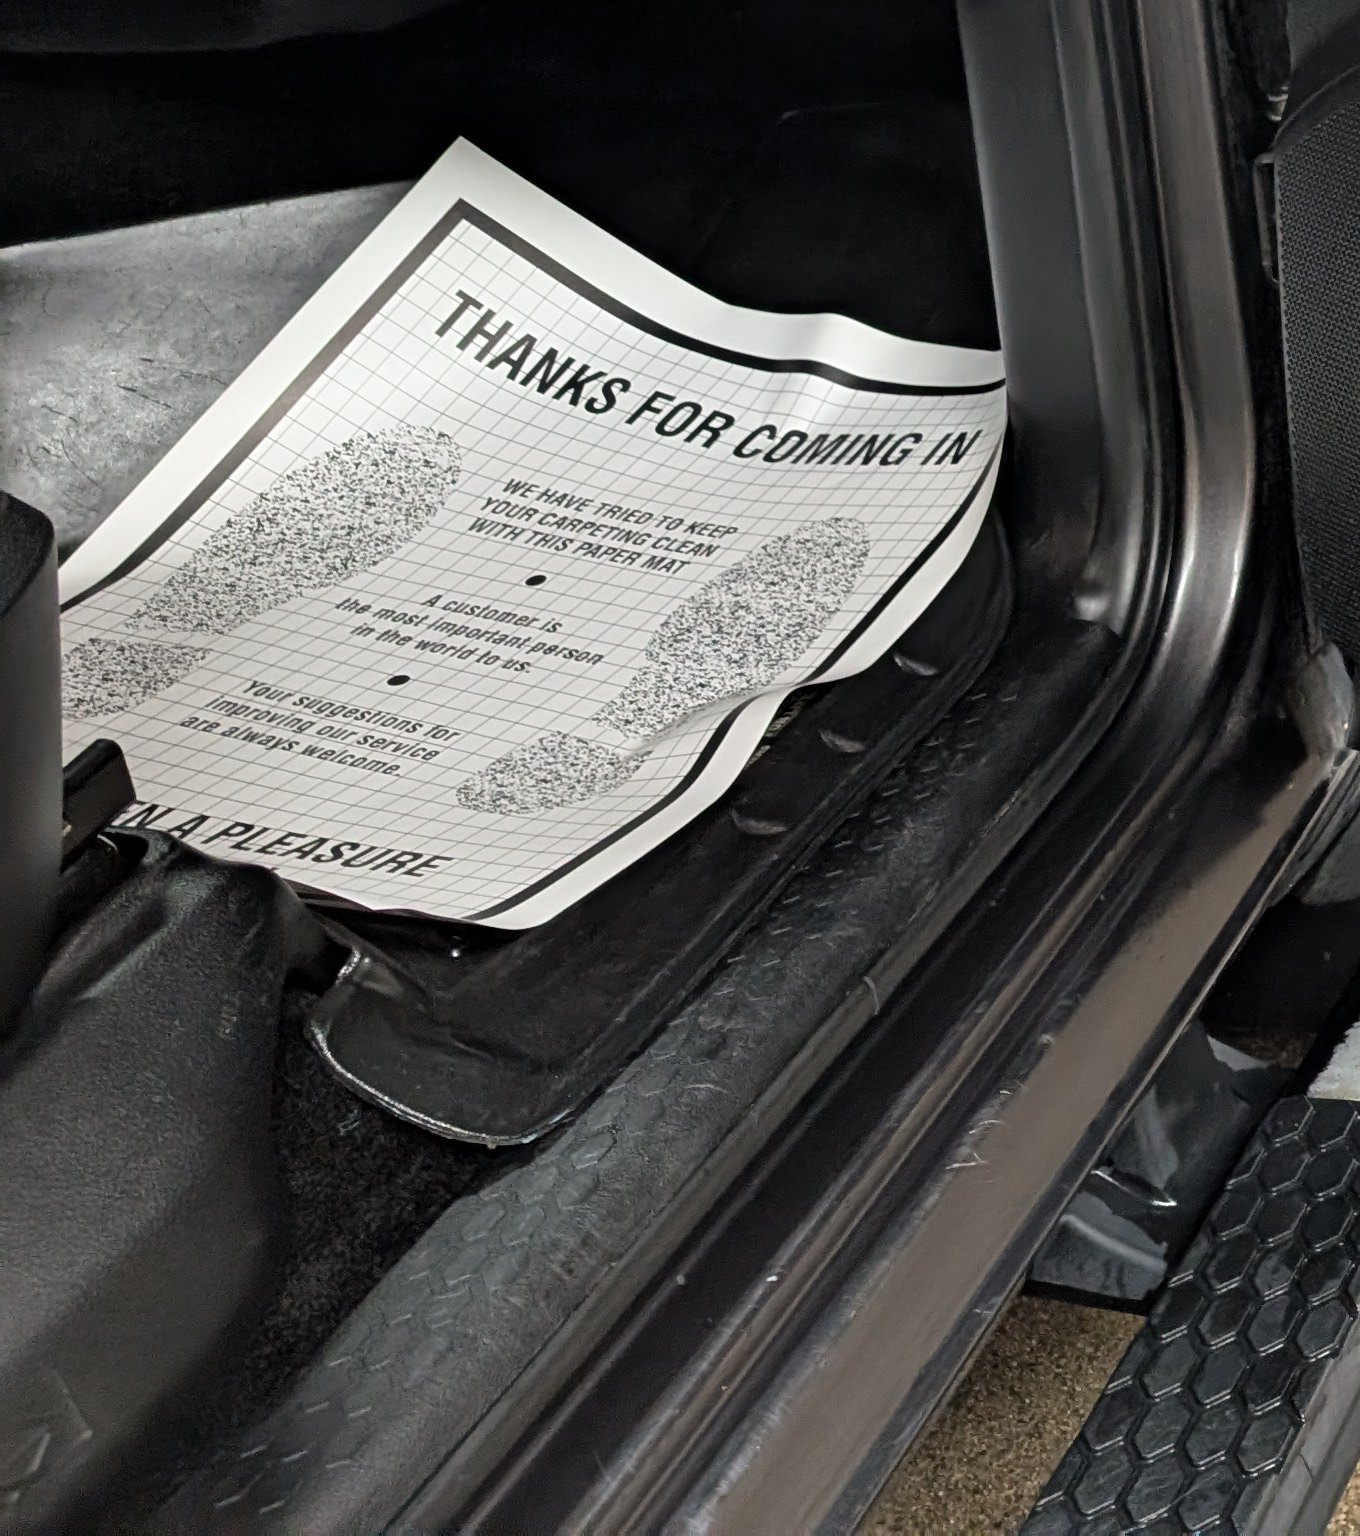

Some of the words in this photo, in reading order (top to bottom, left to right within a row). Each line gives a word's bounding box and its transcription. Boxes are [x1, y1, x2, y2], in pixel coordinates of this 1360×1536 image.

[434, 289, 632, 415] THANKS
[624, 390, 735, 449] FOR
[732, 423, 924, 466] COMING
[920, 429, 984, 465] IN
[479, 496, 539, 522] YOUR
[537, 512, 653, 547] CARPETING
[652, 535, 721, 558] CLEAN
[501, 478, 541, 499] WE
[537, 489, 594, 513] HAVE
[592, 501, 654, 526] TRIED
[653, 514, 685, 531] TO
[684, 520, 739, 540] KEEP
[467, 517, 524, 541] WITH
[524, 529, 574, 552] THIS
[573, 540, 642, 565] PAPER
[641, 555, 691, 575] MAT
[335, 597, 372, 614] the
[372, 606, 430, 627] most
[428, 616, 533, 649] important
[527, 642, 604, 665] person
[420, 594, 443, 608] A
[442, 599, 539, 628] customer
[538, 617, 563, 633] is
[350, 622, 376, 636] in
[376, 628, 413, 646] the
[415, 637, 480, 661] world
[476, 649, 500, 666] to
[501, 658, 532, 674] us.
[204, 695, 314, 734] improving
[315, 723, 358, 742] our
[355, 734, 442, 762] service
[242, 679, 294, 703] Your
[292, 693, 424, 733] suggestions
[422, 723, 462, 742] for
[179, 714, 221, 733] are
[220, 724, 300, 752] always
[300, 742, 402, 777] welcome.
[166, 814, 212, 840] A
[201, 821, 456, 878] PLEASURE
